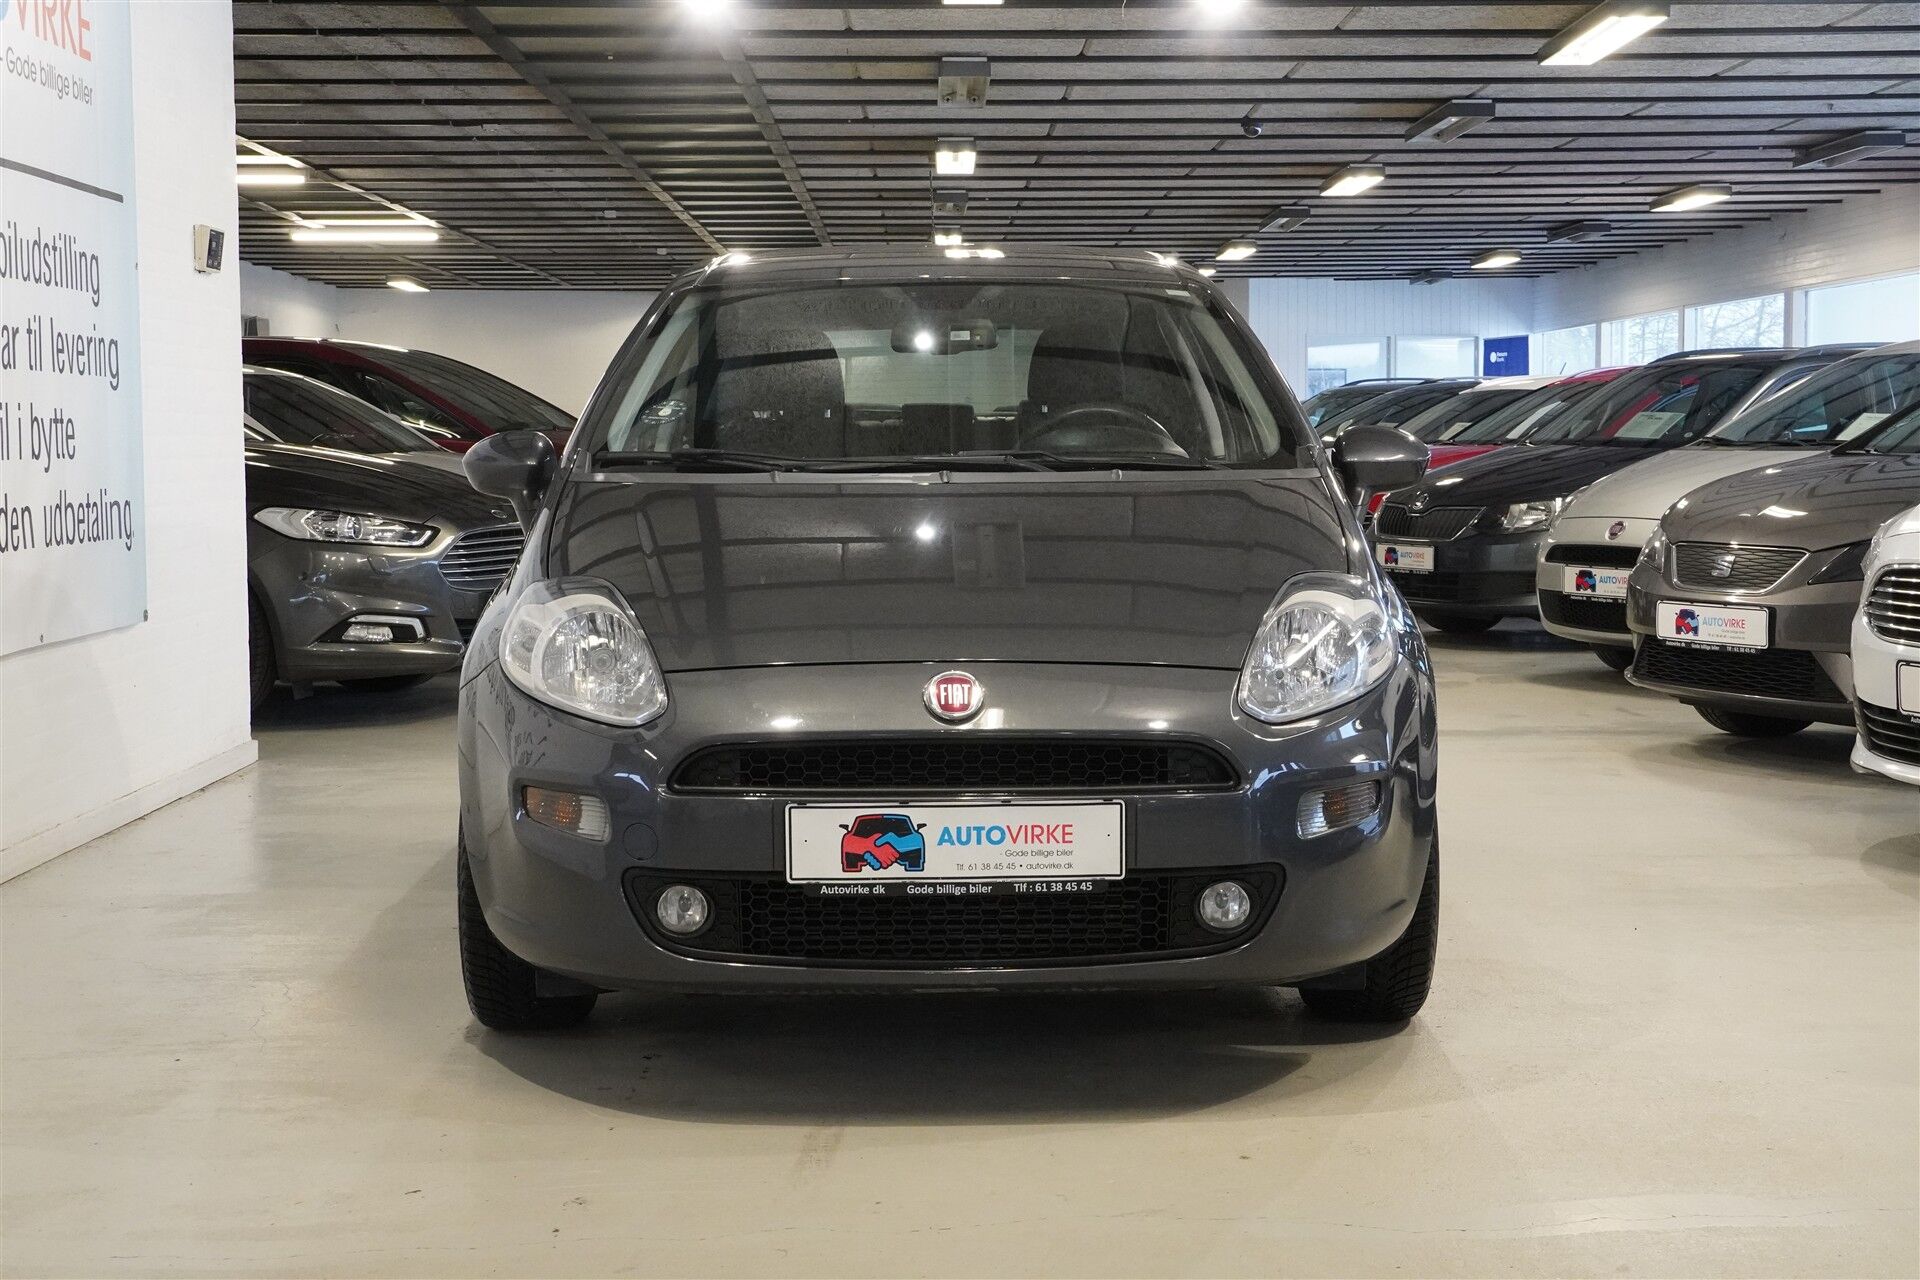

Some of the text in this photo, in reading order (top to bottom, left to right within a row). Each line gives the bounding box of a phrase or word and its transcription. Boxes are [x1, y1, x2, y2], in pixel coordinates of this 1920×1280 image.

[6, 46, 37, 82] Gode
[40, 61, 69, 99] billige
[72, 75, 93, 105] biler
[26, 314, 43, 371] til
[50, 317, 120, 391] levering
[18, 402, 22, 460] i
[30, 402, 76, 473] bytte
[1702, 616, 1746, 629] AUTOVIRKE
[939, 683, 971, 705] FIAT
[937, 824, 1074, 846] AUTOVIRKE
[1004, 849, 1029, 857] Gode
[1031, 849, 1054, 859] billige
[1056, 849, 1074, 857] biler
[968, 863, 978, 871] 61
[981, 863, 991, 871] 38
[993, 862, 1004, 870] 45
[1006, 862, 1017, 870] 45
[1025, 862, 1074, 870] autovirke.dk
[820, 885, 870, 894] Autovirke
[872, 885, 886, 894] dk
[906, 885, 934, 894] Gode
[936, 884, 967, 896] billige
[969, 884, 992, 894] biler
[1013, 883, 1027, 892] Tlf
[1035, 882, 1048, 892] 61
[1050, 882, 1063, 892] 38
[1065, 882, 1078, 891] 45
[1080, 882, 1093, 891] 45
